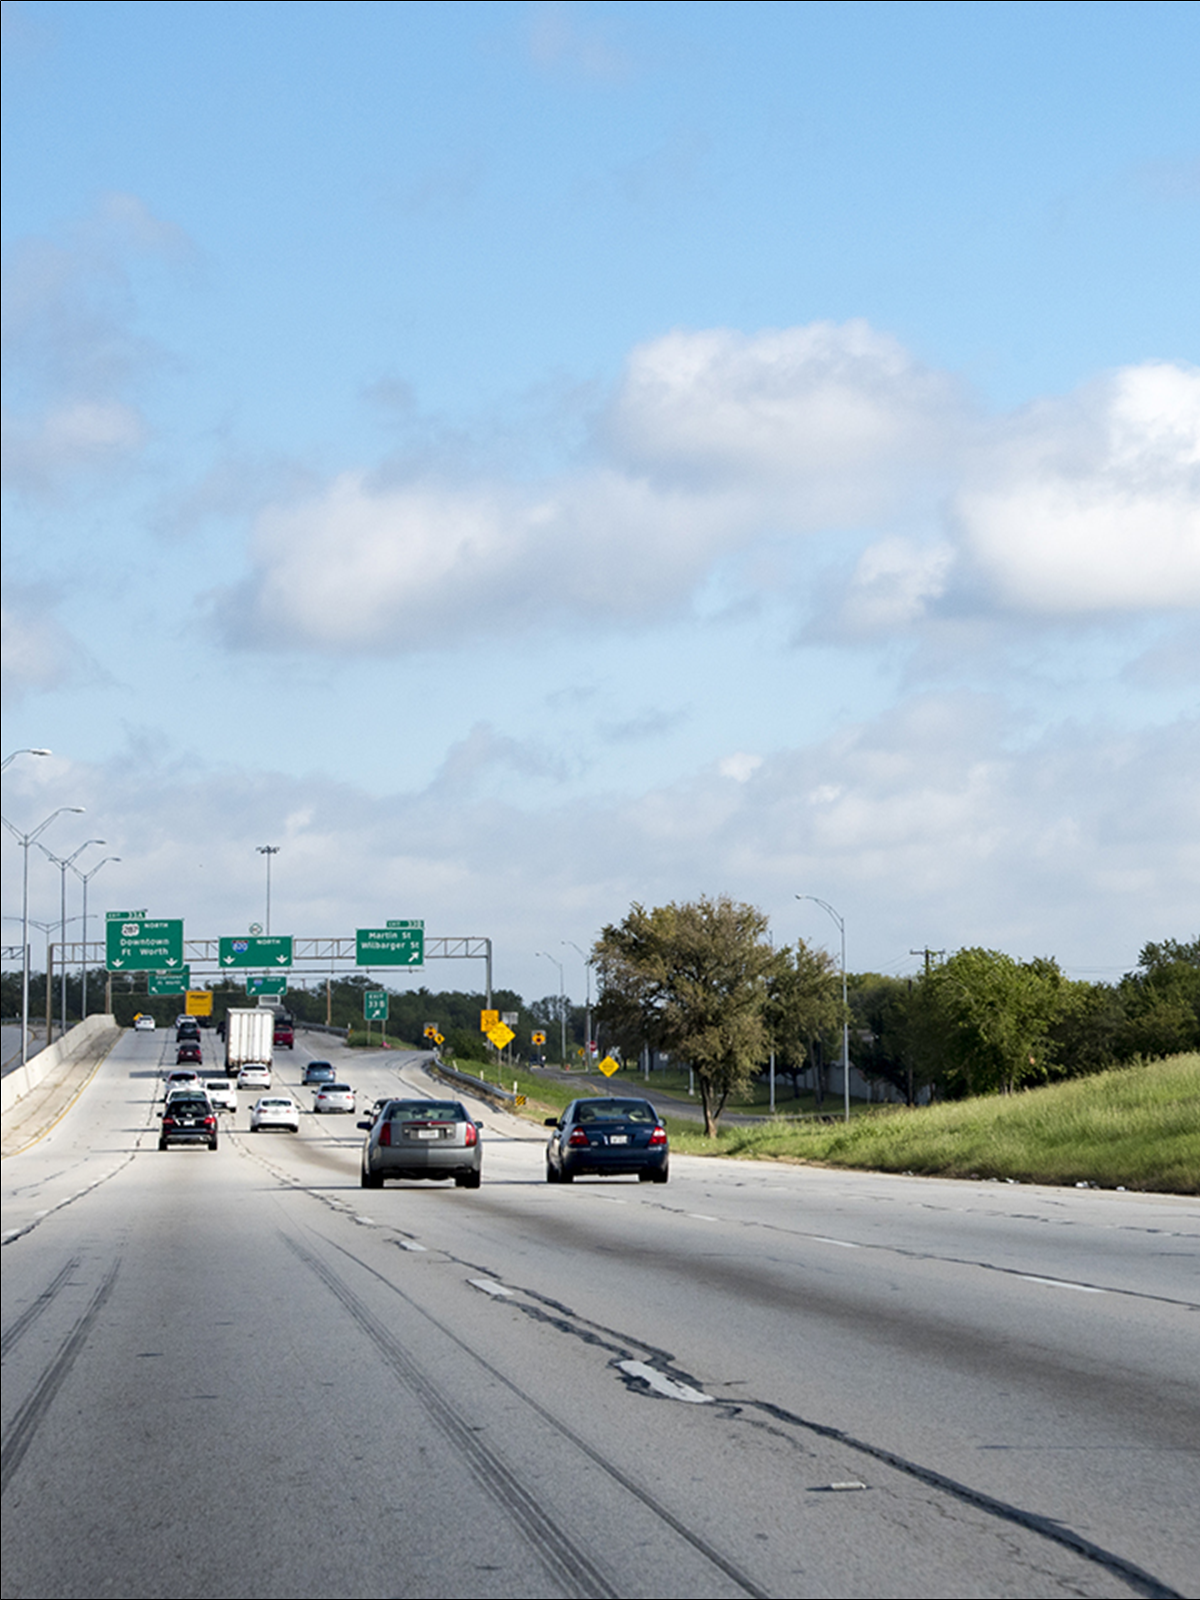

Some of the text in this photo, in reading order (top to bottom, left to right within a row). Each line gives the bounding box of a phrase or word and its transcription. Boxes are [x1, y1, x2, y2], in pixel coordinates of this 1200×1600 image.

[123, 925, 139, 935] 287
[368, 931, 412, 939] Martin St
[120, 938, 170, 947] Downtown
[361, 941, 420, 951] Wilbarger St
[121, 946, 169, 956] Ft Worth
